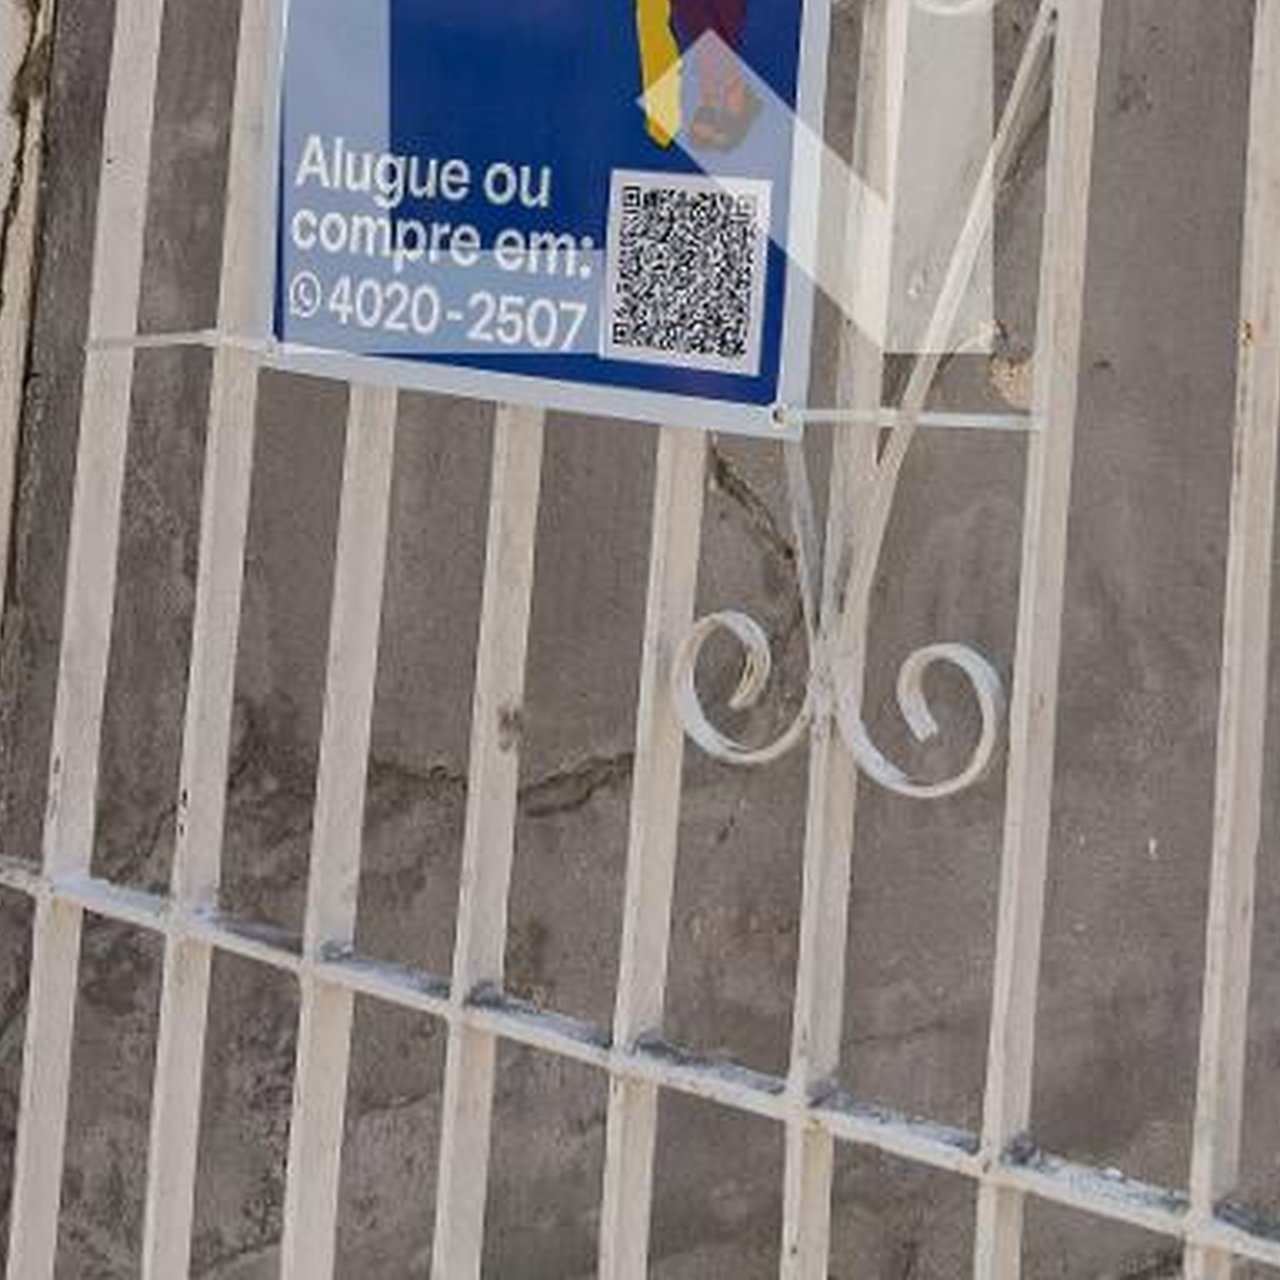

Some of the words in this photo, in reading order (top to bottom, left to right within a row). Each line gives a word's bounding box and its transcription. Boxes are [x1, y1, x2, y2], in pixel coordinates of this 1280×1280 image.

[295, 135, 472, 208] Alugue
[483, 161, 551, 209] ou
[291, 208, 481, 272] compre
[493, 227, 594, 280] em:
[328, 280, 588, 352] 4020-2507
